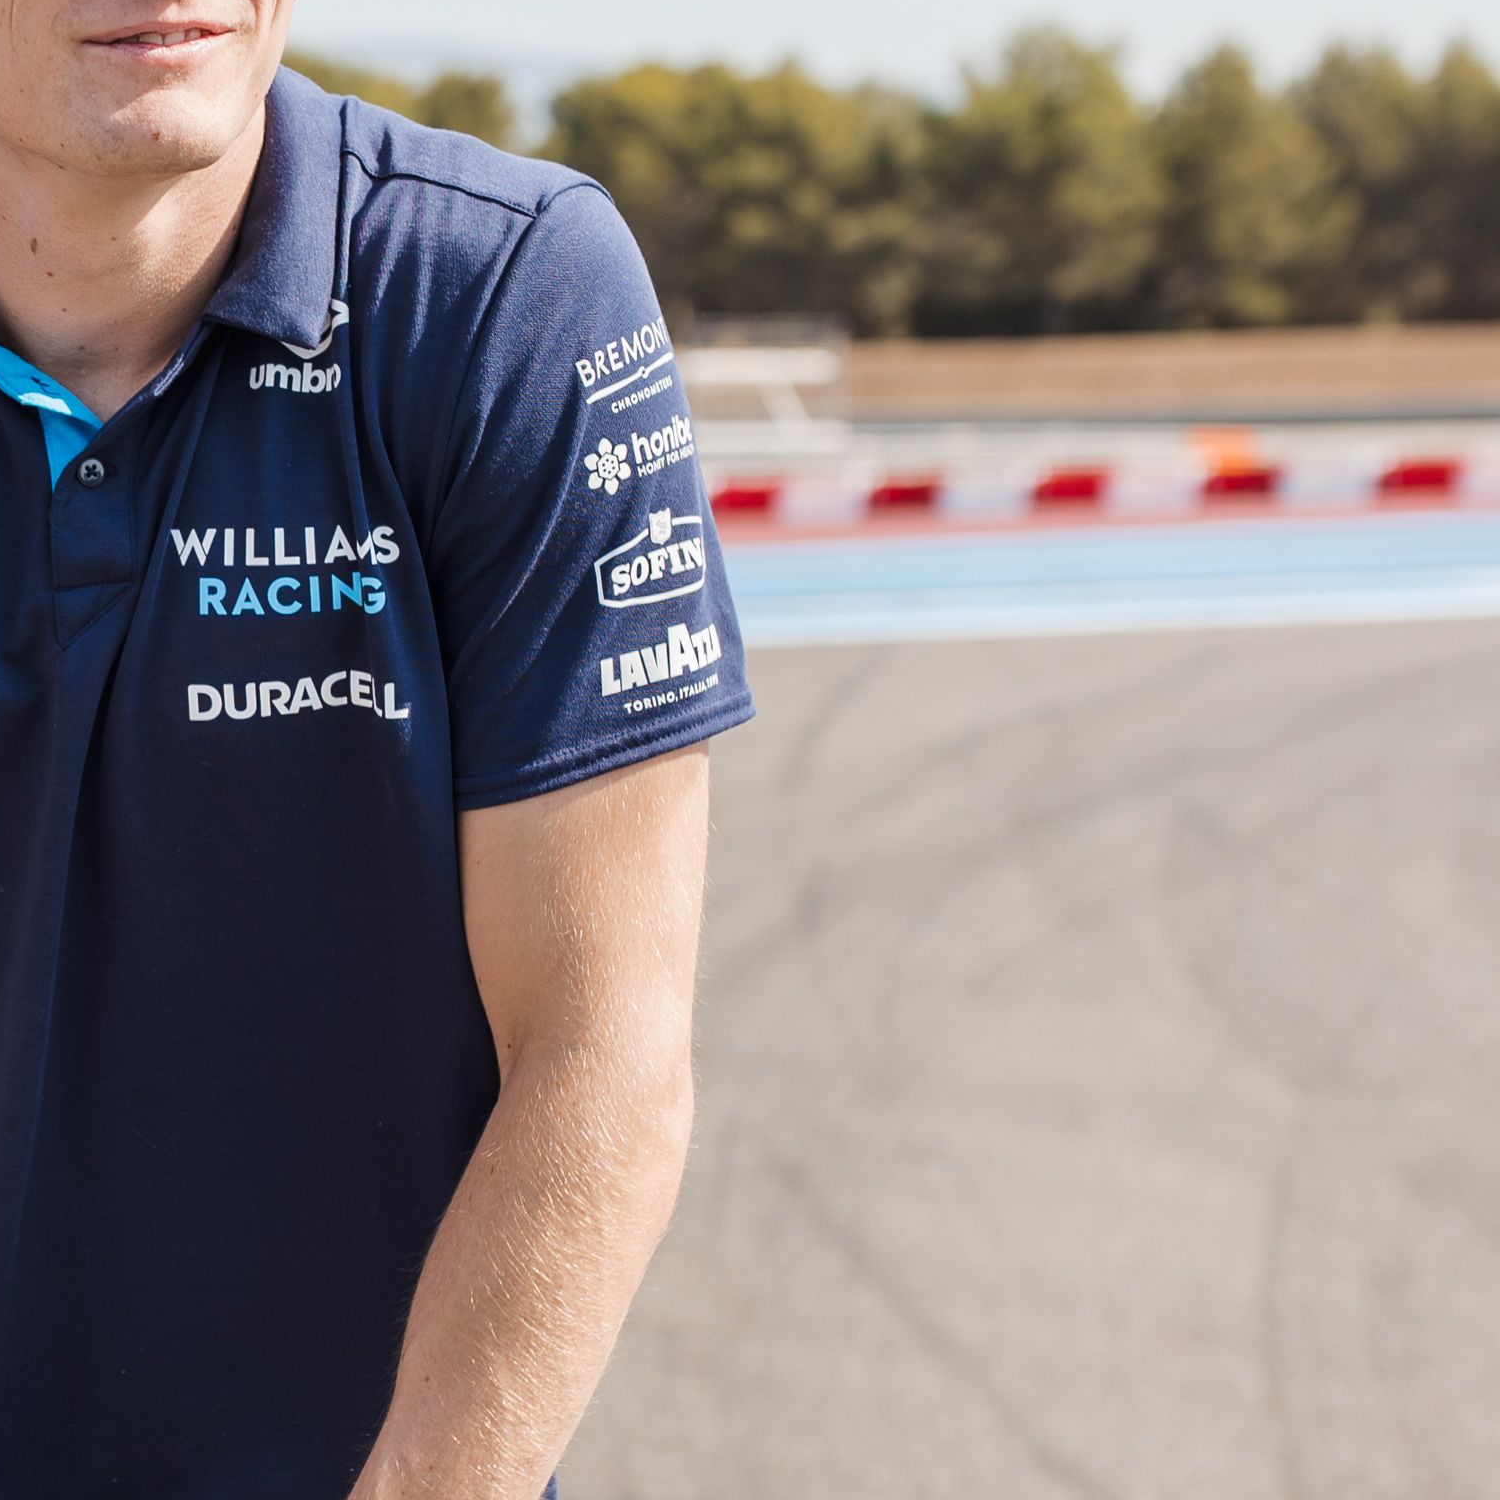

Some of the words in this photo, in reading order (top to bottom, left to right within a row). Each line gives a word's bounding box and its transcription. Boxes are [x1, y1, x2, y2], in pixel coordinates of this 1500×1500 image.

[611, 375, 673, 414] CHRONOMETERS
[199, 571, 386, 616] RACING
[624, 690, 679, 715] TORINO,
